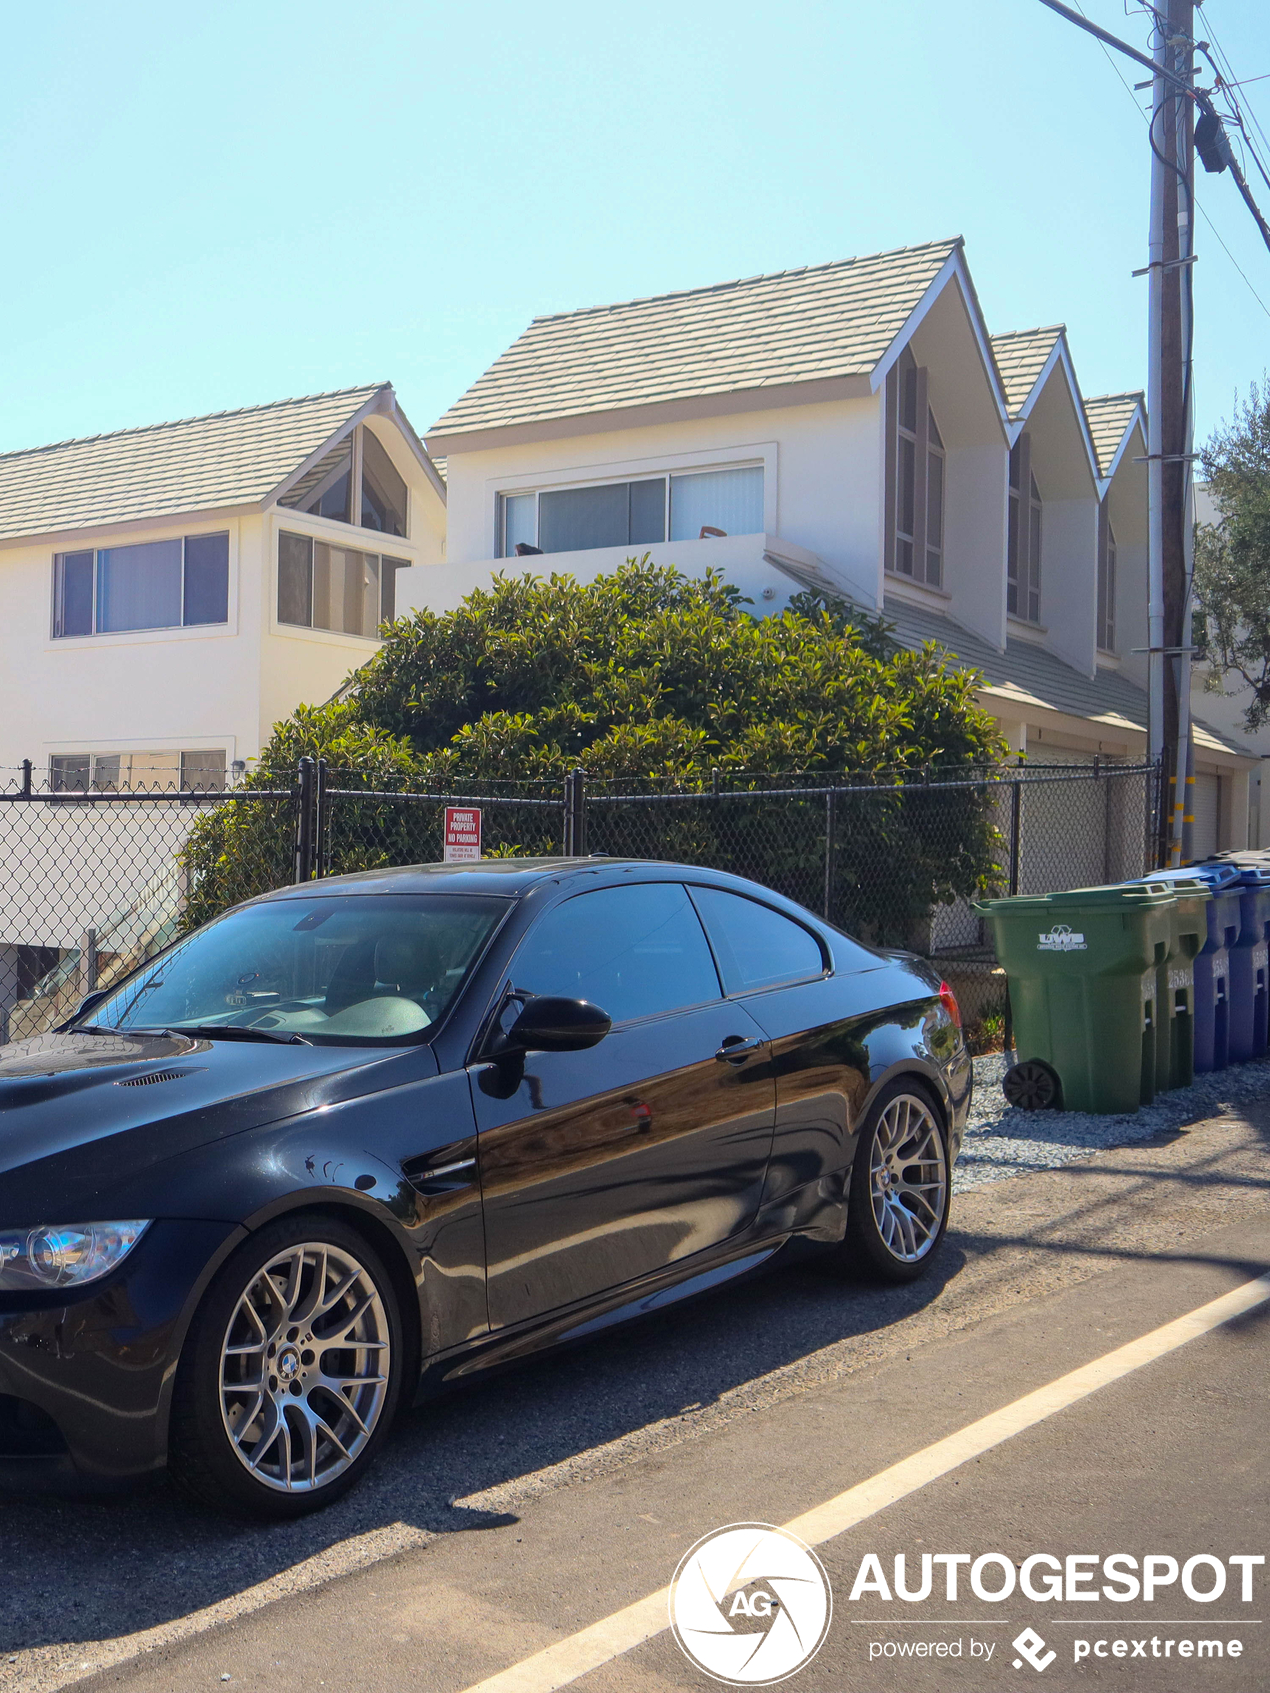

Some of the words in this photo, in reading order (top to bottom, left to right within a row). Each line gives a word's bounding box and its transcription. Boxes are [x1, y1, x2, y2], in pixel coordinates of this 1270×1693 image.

[453, 812, 474, 822] PRIVATE
[450, 821, 476, 831] PROPERTY
[448, 833, 456, 843] NO
[457, 834, 477, 843] PARKING
